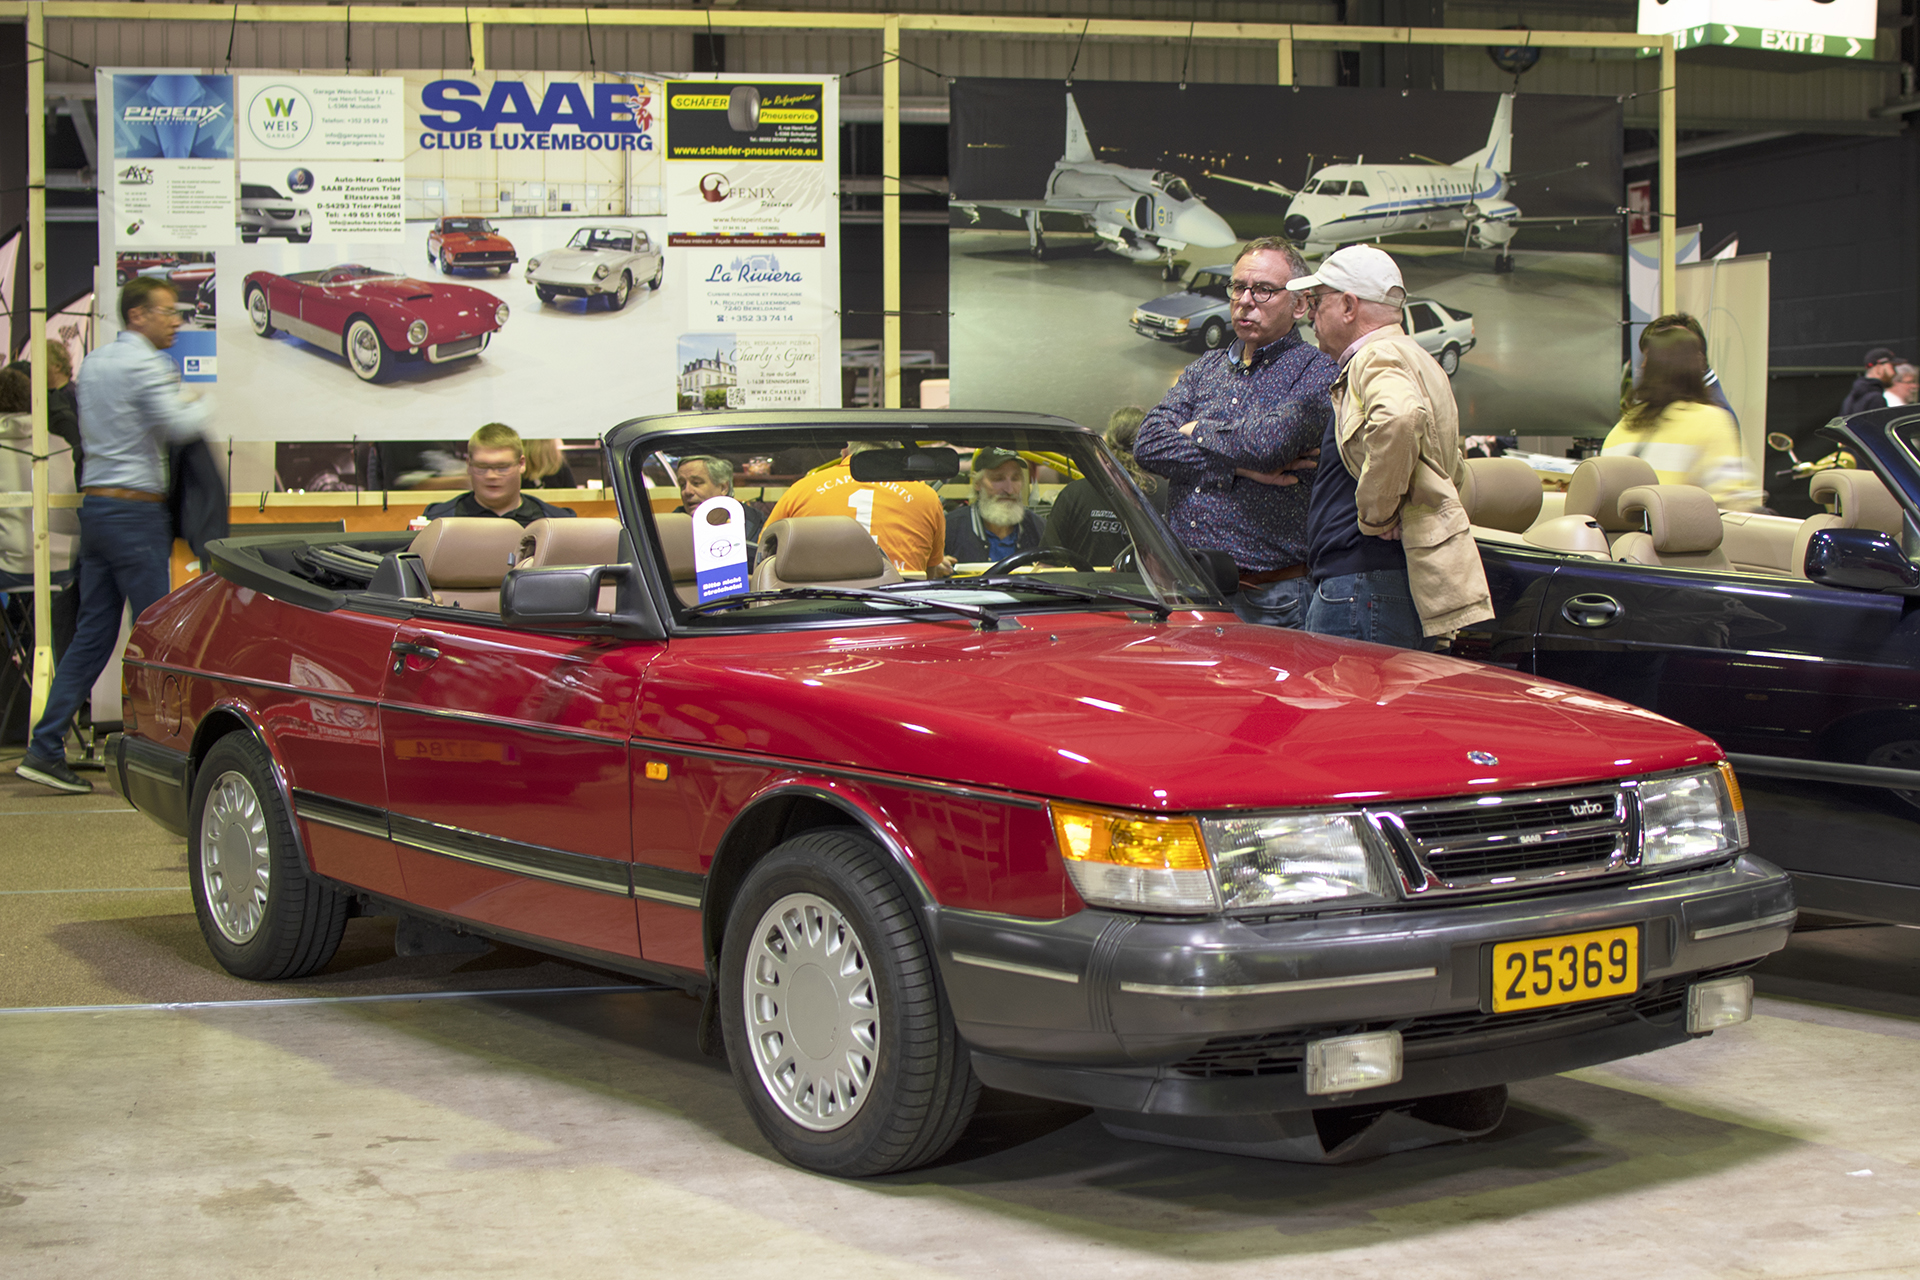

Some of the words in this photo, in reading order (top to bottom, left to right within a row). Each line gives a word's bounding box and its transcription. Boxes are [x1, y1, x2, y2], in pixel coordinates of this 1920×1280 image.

[1761, 28, 1809, 52] EXIT
[313, 88, 336, 96] Garage
[419, 79, 643, 133] SAAB
[675, 97, 728, 108] SCHÄFER
[123, 102, 227, 123] PHOENIX
[761, 111, 815, 120] Pneuservice
[263, 120, 299, 132] WEIS
[419, 133, 483, 150] CLUB
[490, 133, 653, 151] LUXEMBOURG
[673, 145, 818, 158] www.schaefer-pneuservice.eu
[729, 187, 775, 199] FENIX
[712, 216, 780, 224] www.fenixpeinture.lu
[705, 264, 733, 283] La
[737, 264, 803, 283] Riviera
[729, 346, 781, 369] Charly's
[784, 347, 816, 369] Gare
[1569, 800, 1603, 817] turbo
[1505, 939, 1628, 1001] 25369
